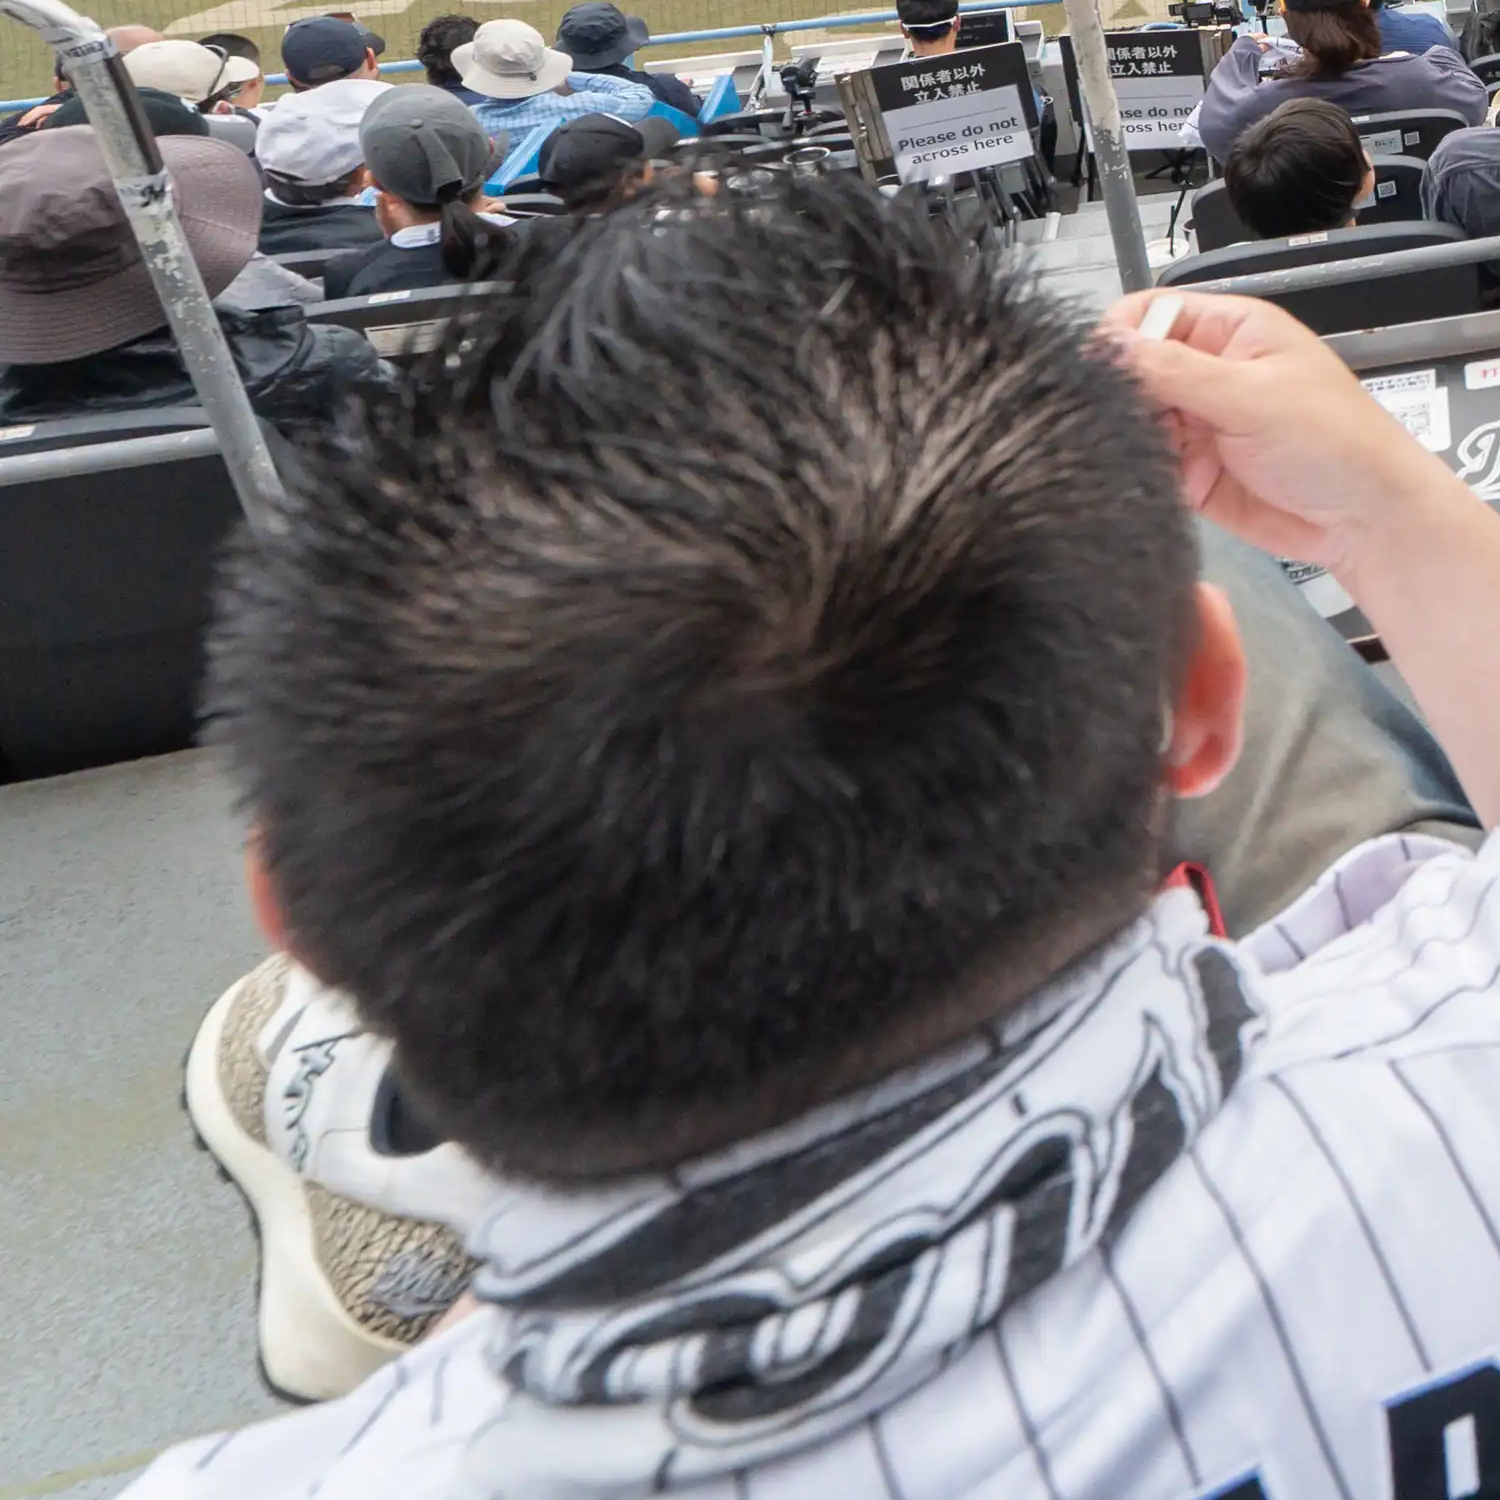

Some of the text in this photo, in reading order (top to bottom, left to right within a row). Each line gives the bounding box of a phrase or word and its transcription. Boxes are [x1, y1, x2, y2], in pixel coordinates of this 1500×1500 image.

[899, 62, 987, 92] 関係者以外
[1110, 59, 1173, 76] 立入禁止
[1152, 104, 1171, 119] do
[898, 116, 1019, 155] Please do not
[911, 131, 1014, 166] across here
